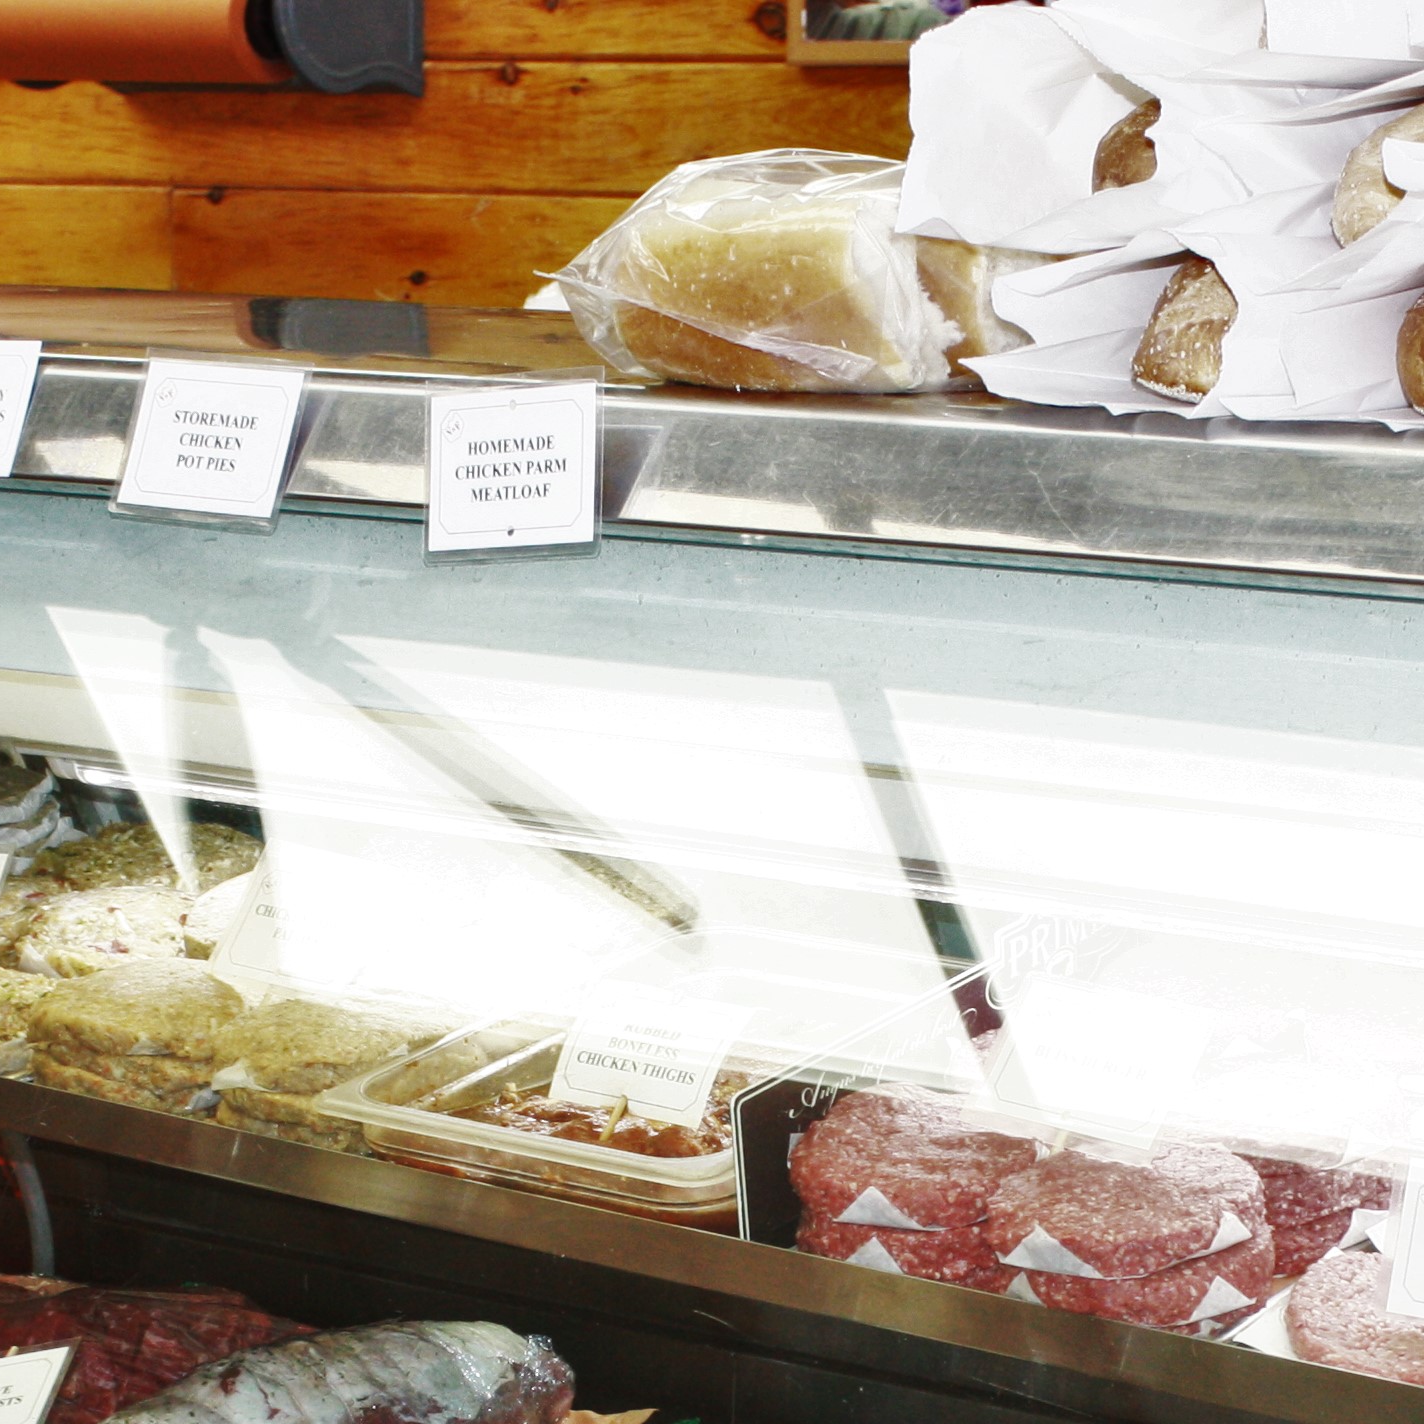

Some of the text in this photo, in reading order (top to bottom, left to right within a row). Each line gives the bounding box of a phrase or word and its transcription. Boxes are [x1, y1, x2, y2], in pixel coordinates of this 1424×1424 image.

[173, 410, 259, 430] STOREMADE
[179, 432, 244, 450] CHICKEN
[468, 434, 556, 456] HOMEMADE
[176, 454, 236, 472] POT PIES
[455, 458, 567, 480] CHICKEN PARM
[471, 483, 551, 503] MEATLOAF
[608, 1036, 681, 1060] BONELESS
[576, 1050, 697, 1087] CHICKEN THIGHS
